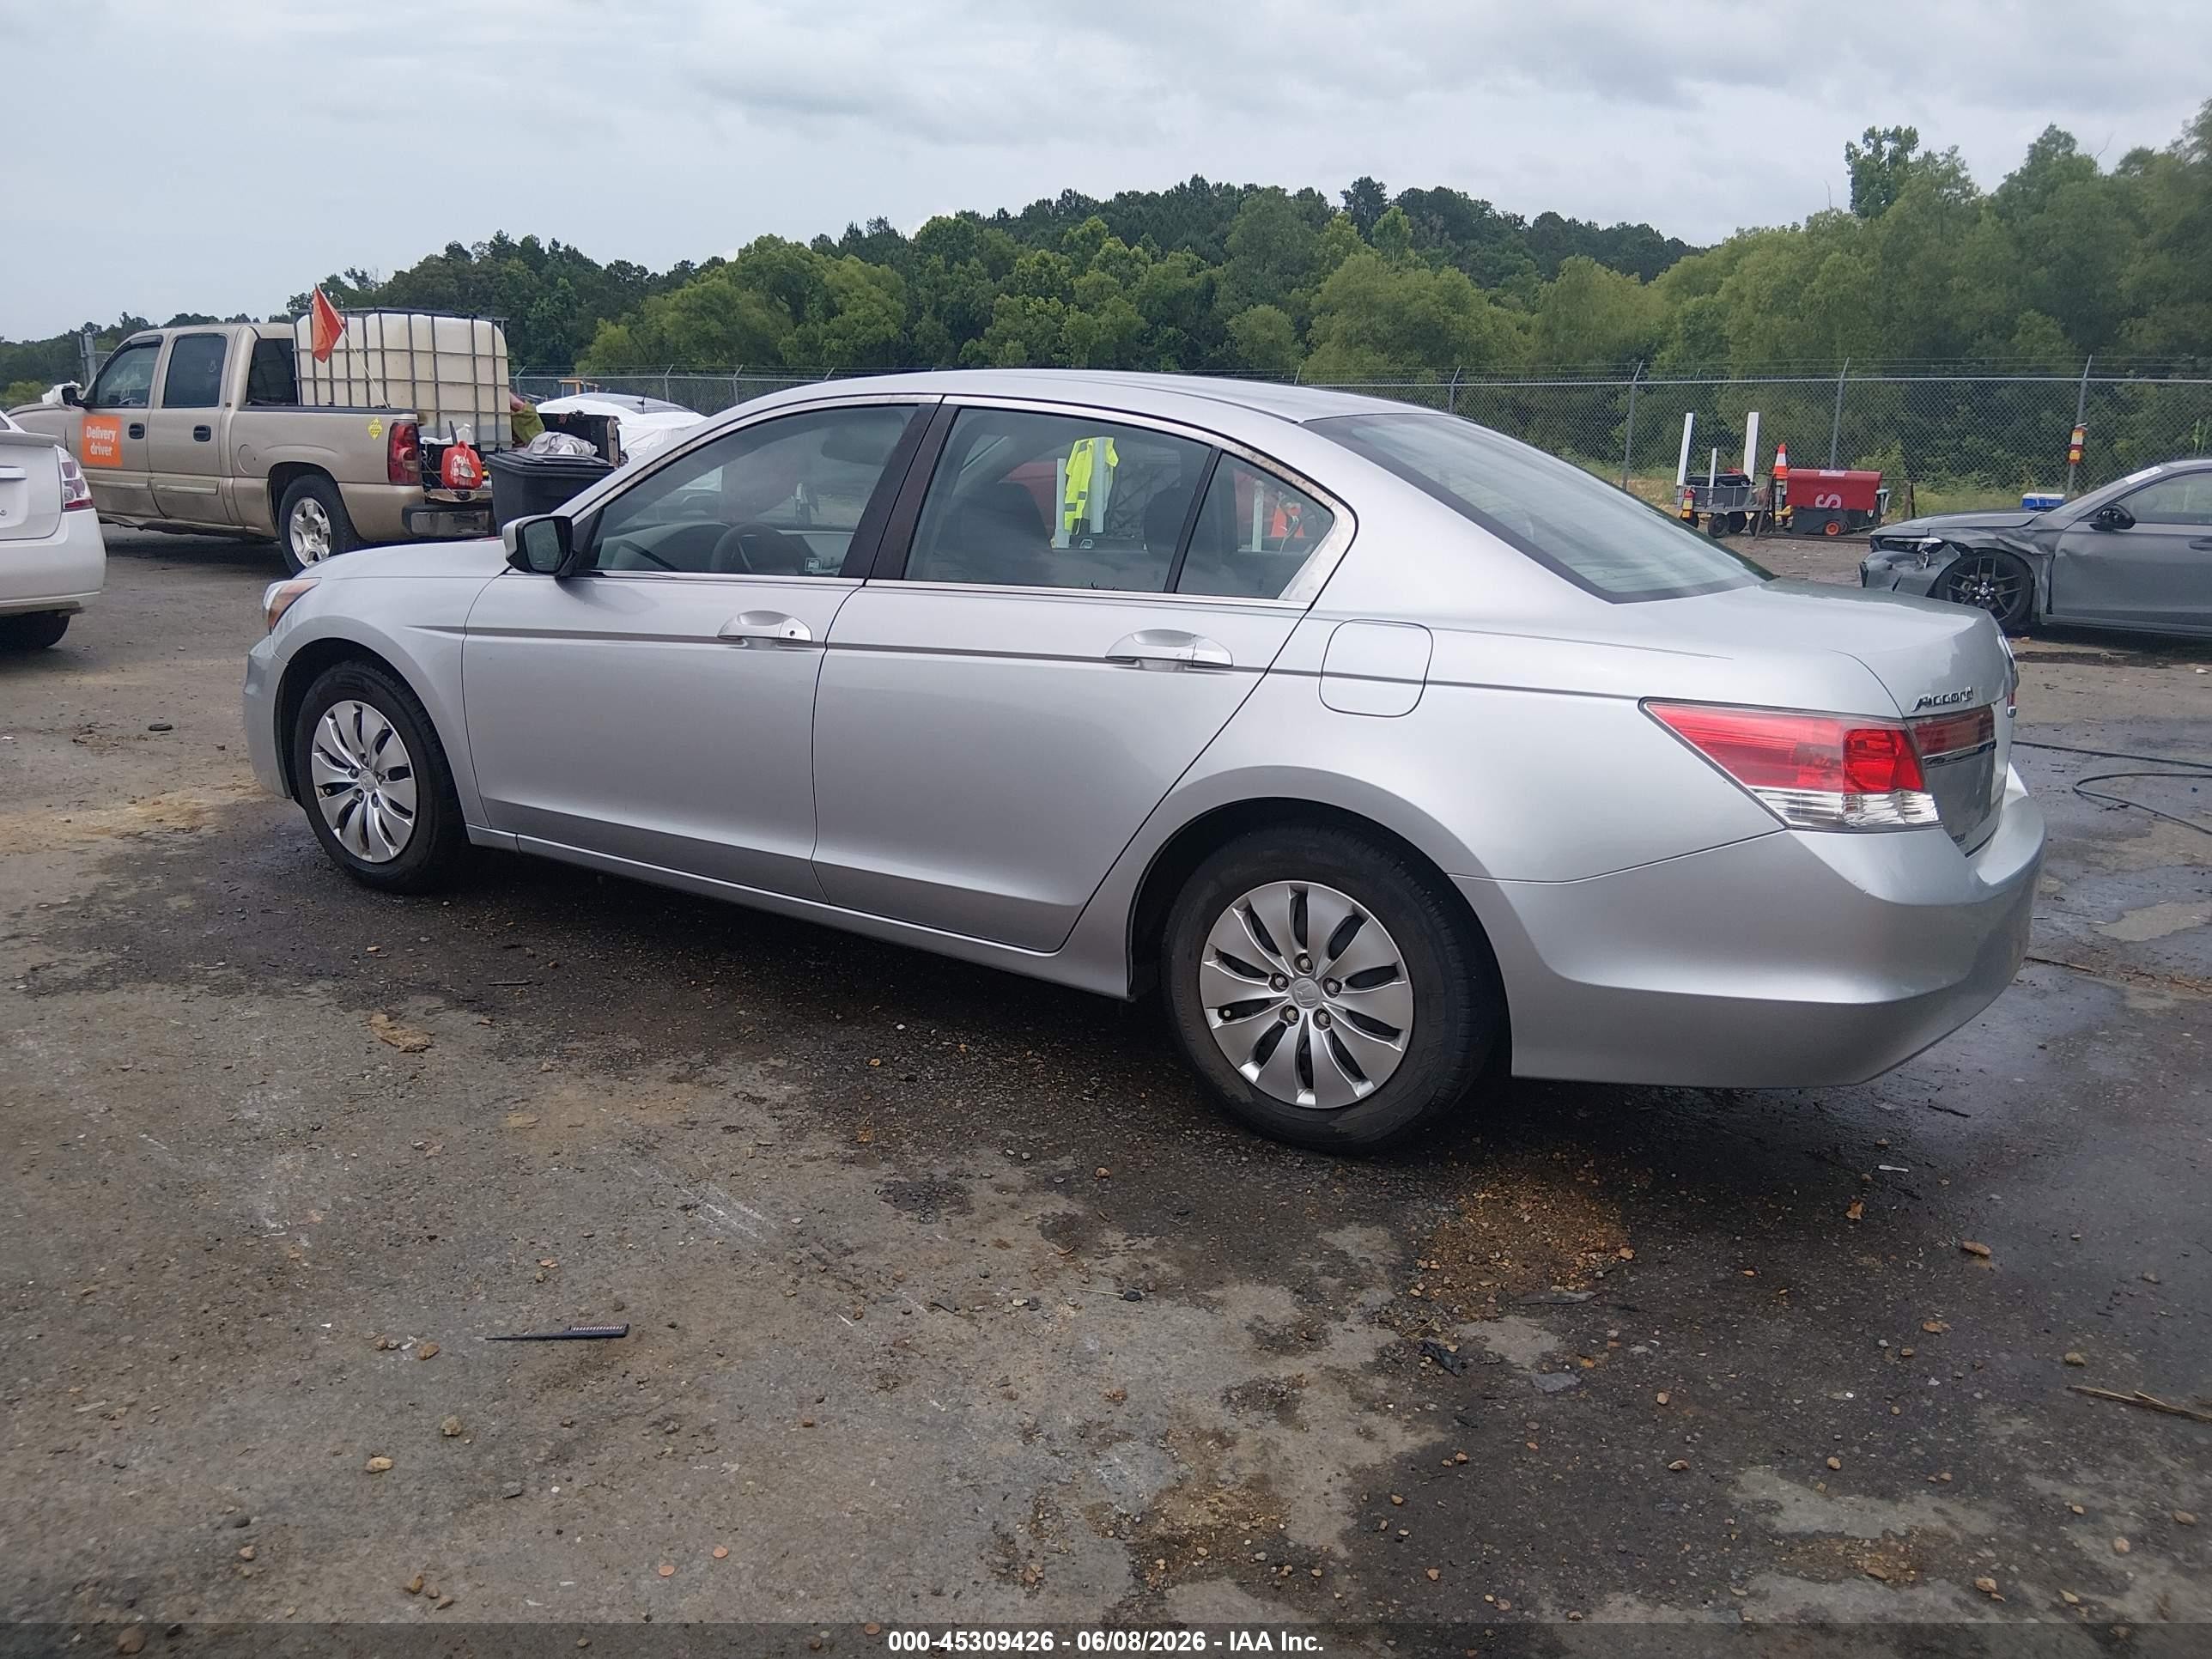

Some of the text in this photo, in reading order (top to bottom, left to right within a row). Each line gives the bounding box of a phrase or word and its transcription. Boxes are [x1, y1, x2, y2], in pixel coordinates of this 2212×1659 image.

[86, 425, 117, 443] Delivery
[90, 441, 112, 457] driver
[1910, 686, 1973, 713] Accord
